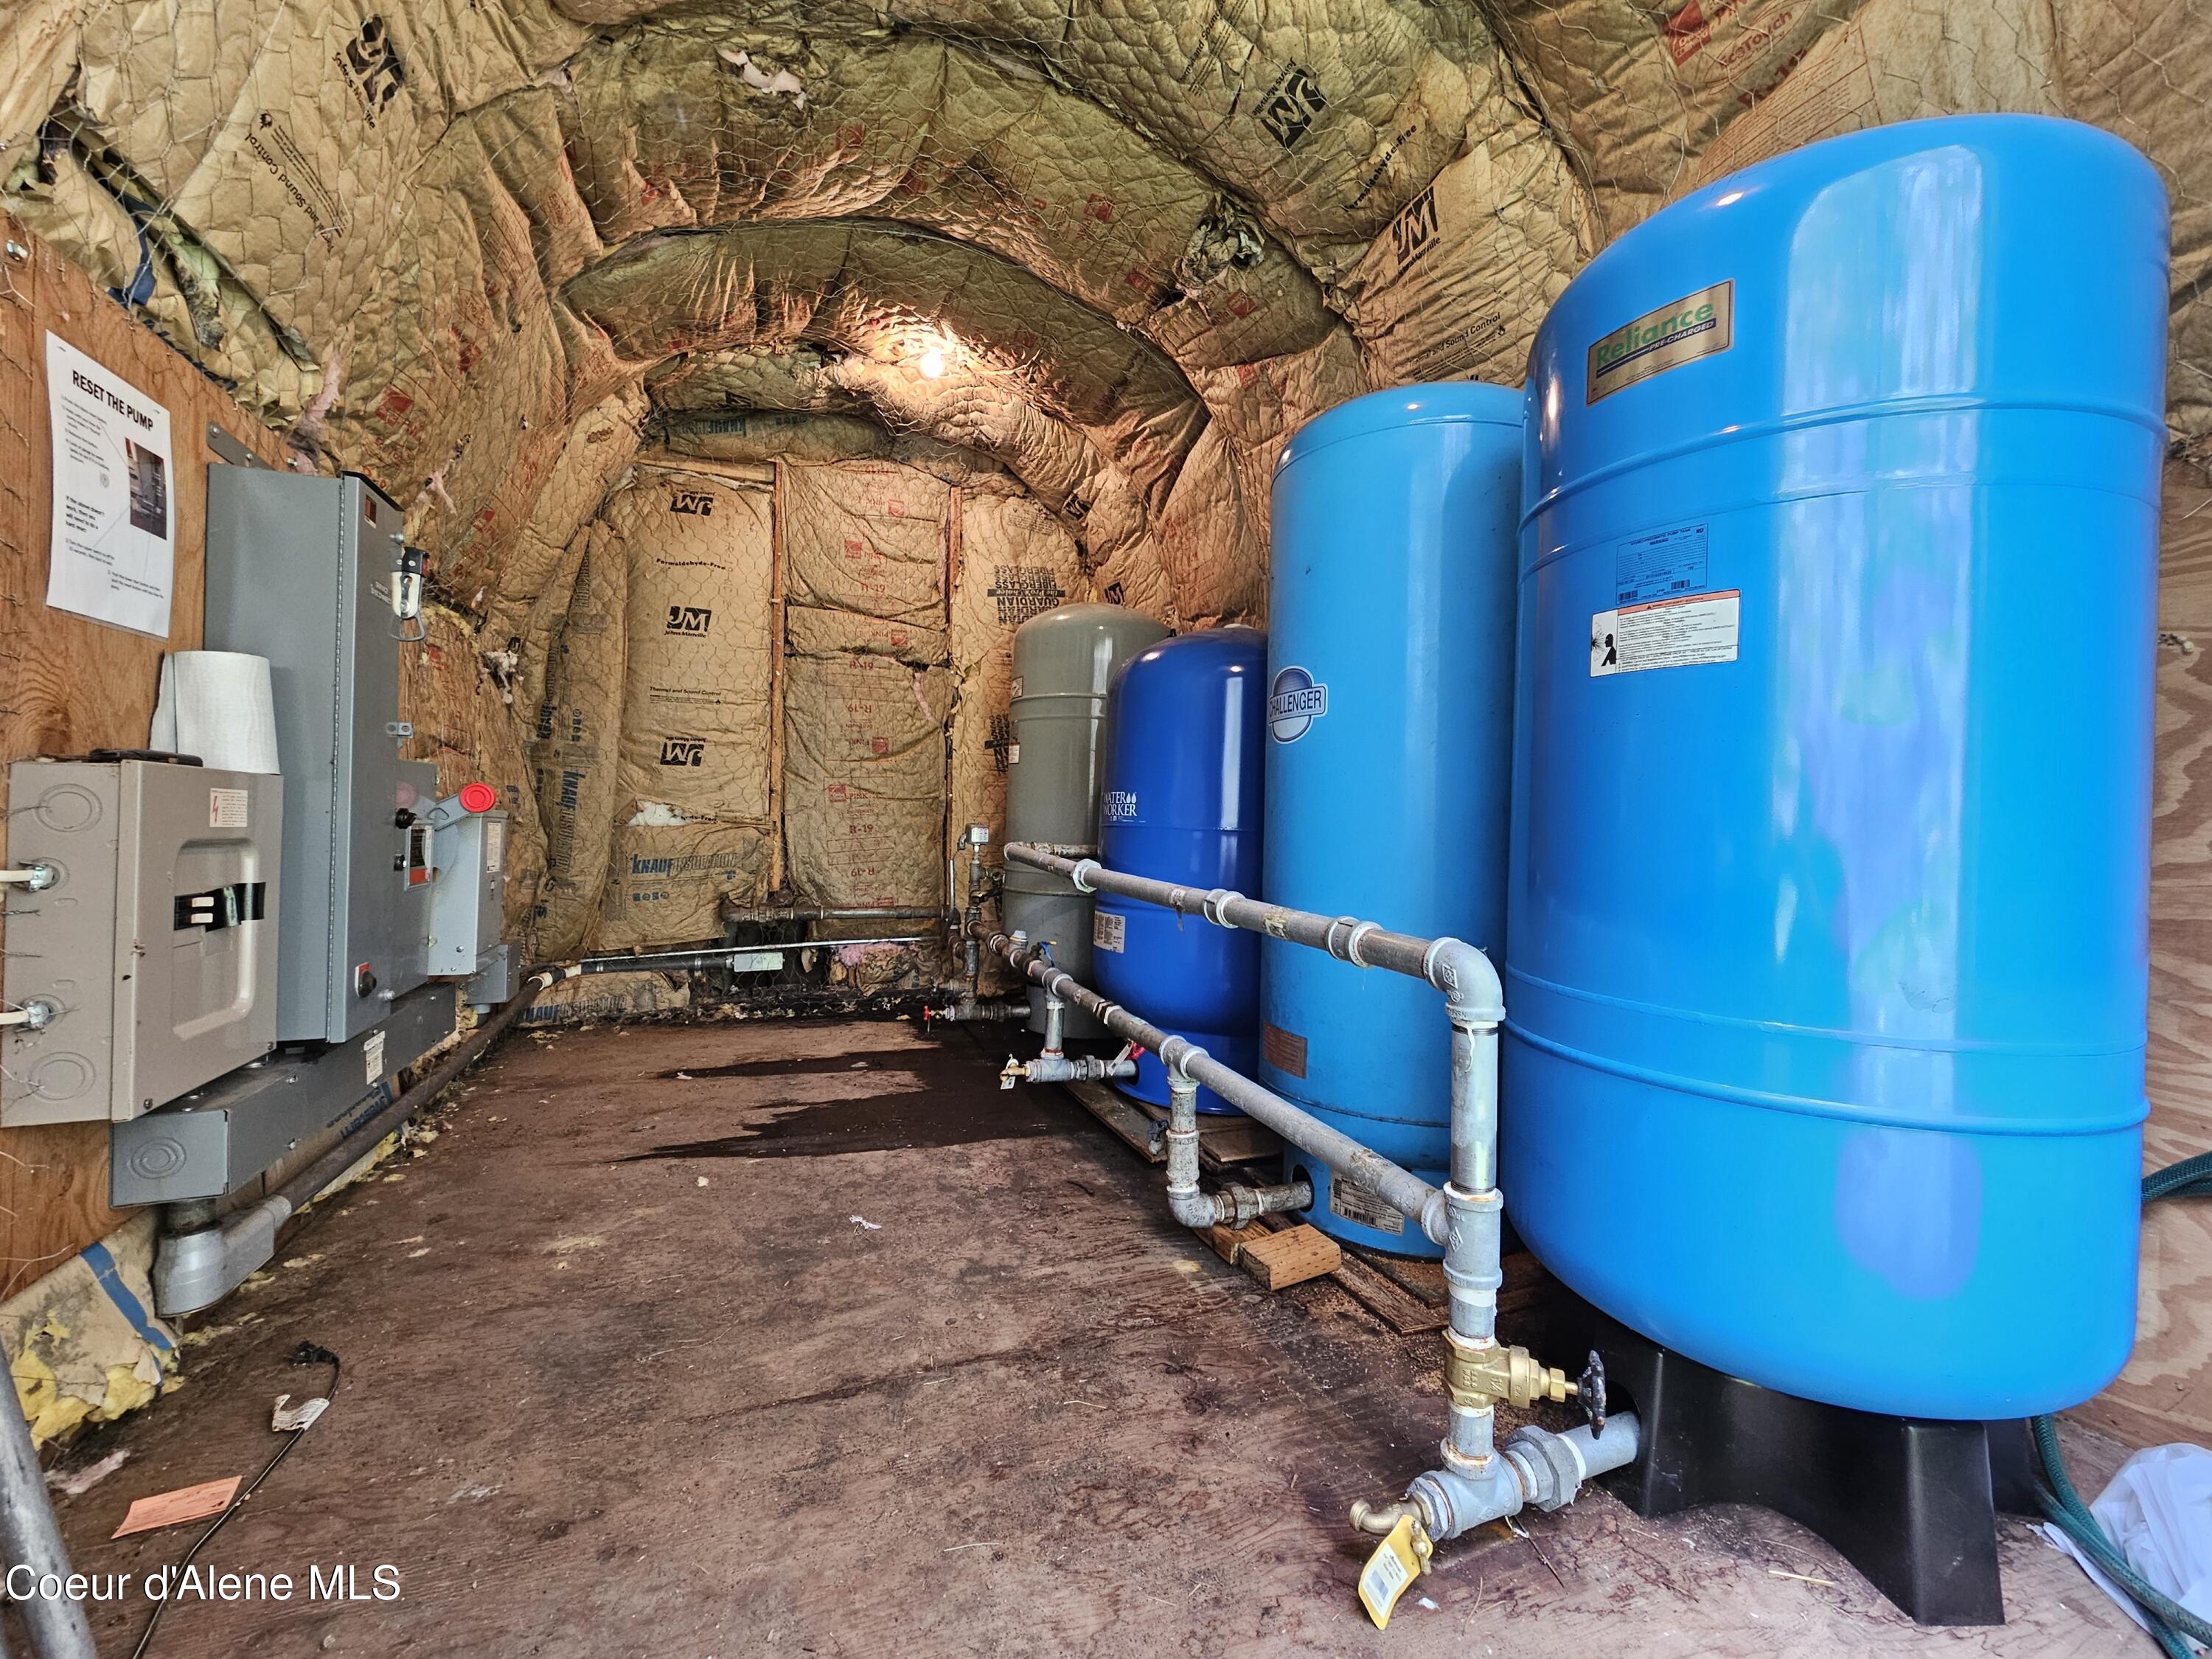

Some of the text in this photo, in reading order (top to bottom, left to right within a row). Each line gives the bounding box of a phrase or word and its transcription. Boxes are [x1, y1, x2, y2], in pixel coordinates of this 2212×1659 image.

[245, 133, 279, 175] Control
[277, 173, 306, 208] Sound
[1470, 312, 1501, 335] Control
[1596, 303, 1715, 369] Reliance
[1649, 320, 1715, 352] PRE-CHARGED
[72, 369, 153, 431] RESET THE PUMP
[995, 580, 1057, 590] FIBERGLASS
[997, 597, 1060, 607] GUARDIAN
[667, 605, 712, 632] JM
[848, 704, 872, 714] R-19
[1269, 689, 1322, 718] CHALLENGER
[660, 741, 705, 767] JM
[849, 824, 874, 834] R-19
[850, 867, 875, 877] R-19
